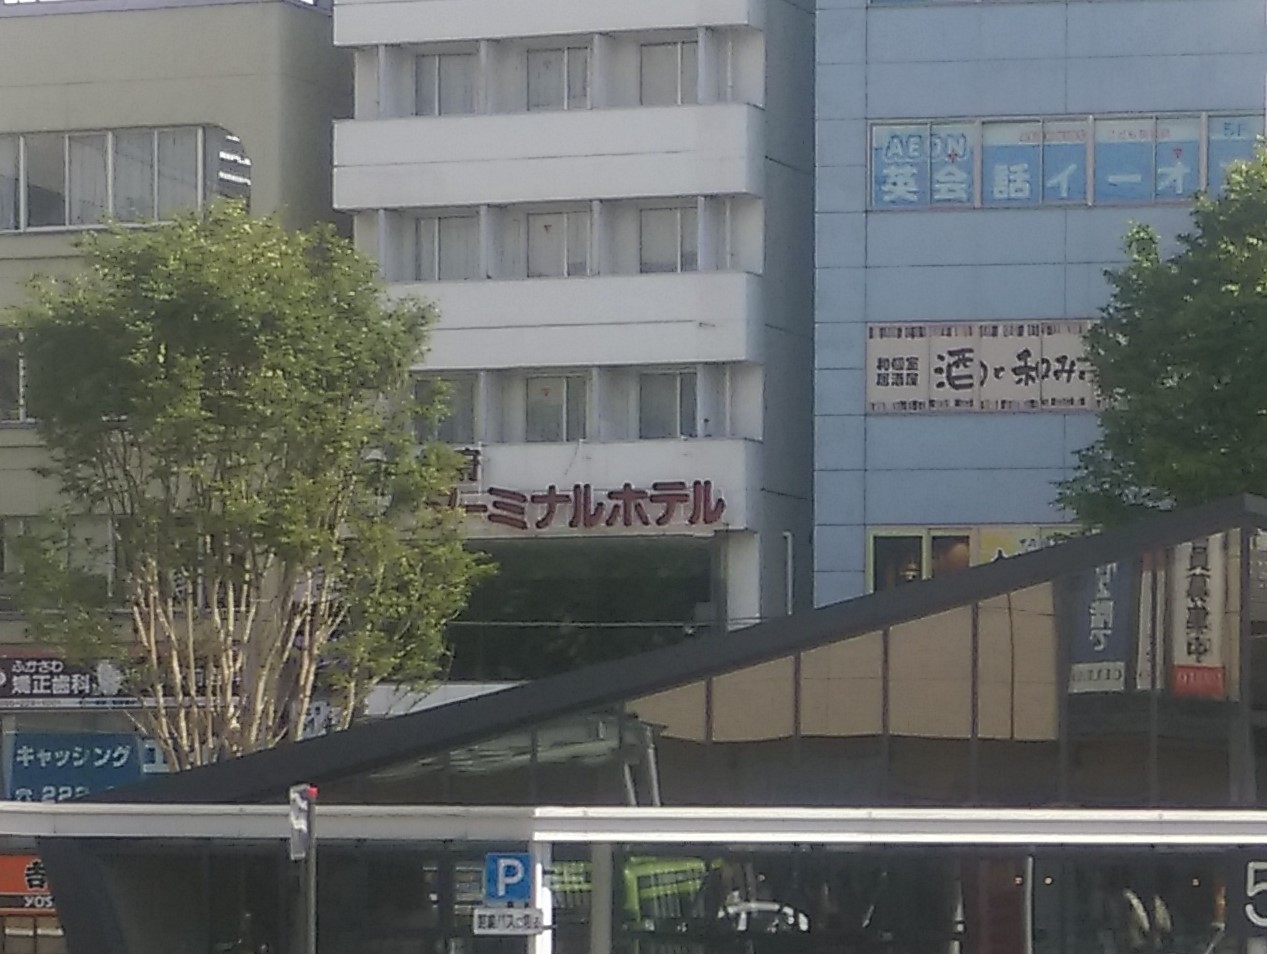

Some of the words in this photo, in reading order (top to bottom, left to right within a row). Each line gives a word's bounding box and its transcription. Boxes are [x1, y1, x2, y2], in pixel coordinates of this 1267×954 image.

[885, 134, 970, 162] AEON
[881, 163, 1193, 201] 英会話イーオ
[16, 745, 131, 767] キャッシング
[497, 859, 524, 896] P
